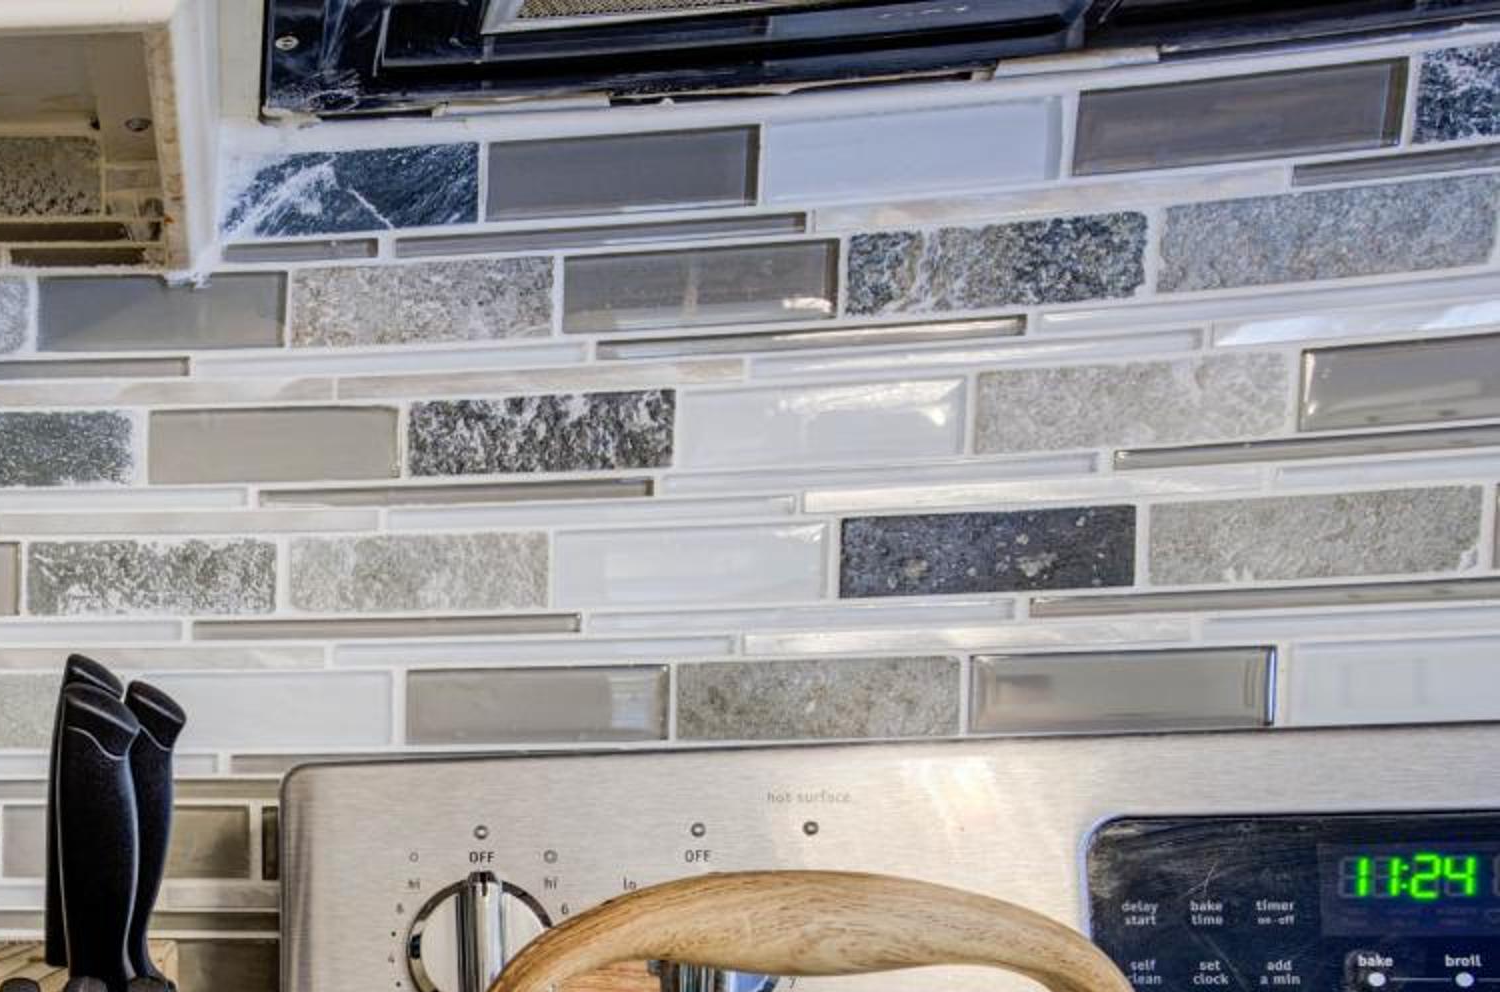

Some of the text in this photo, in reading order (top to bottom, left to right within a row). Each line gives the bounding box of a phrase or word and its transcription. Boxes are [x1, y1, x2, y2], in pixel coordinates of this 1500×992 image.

[767, 789, 851, 804] hot surface
[469, 851, 495, 864] OFF
[685, 850, 711, 863] OFF
[1355, 853, 1478, 899] 11:24
[544, 876, 559, 890] hi
[623, 877, 637, 890] lo
[1121, 900, 1159, 914] delay
[1189, 899, 1223, 911] bake
[1255, 899, 1295, 911] timer
[1125, 914, 1157, 926] start
[1191, 914, 1224, 926] time
[1130, 959, 1157, 971] self
[1199, 960, 1221, 971] set
[1267, 959, 1293, 971] add
[1357, 954, 1393, 967] bake
[1444, 954, 1482, 967] broil
[1193, 973, 1229, 985] clock
[1260, 973, 1301, 985] a min
